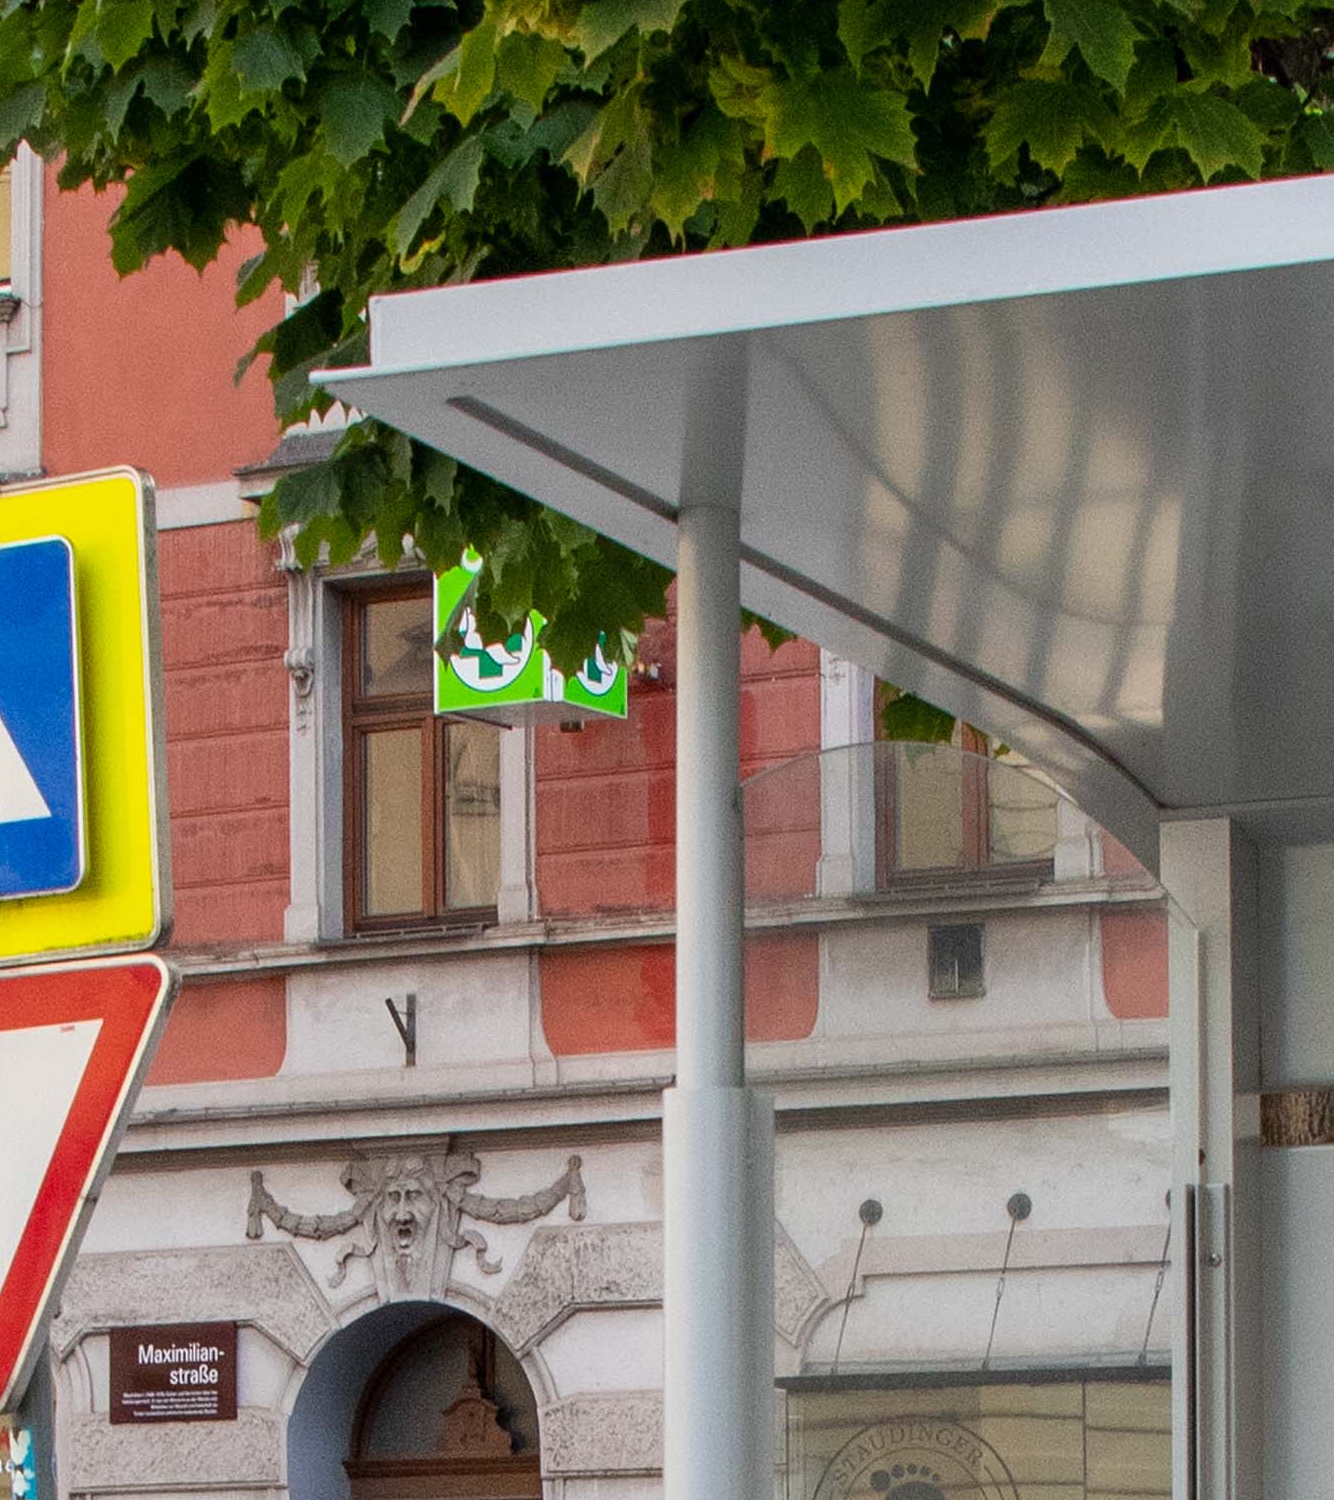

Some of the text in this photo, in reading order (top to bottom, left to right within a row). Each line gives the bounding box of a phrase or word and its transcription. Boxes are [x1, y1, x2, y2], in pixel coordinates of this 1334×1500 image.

[138, 1343, 225, 1364] Maximilian-
[170, 1364, 218, 1385] straße
[835, 1424, 984, 1486] STAUDINGER
